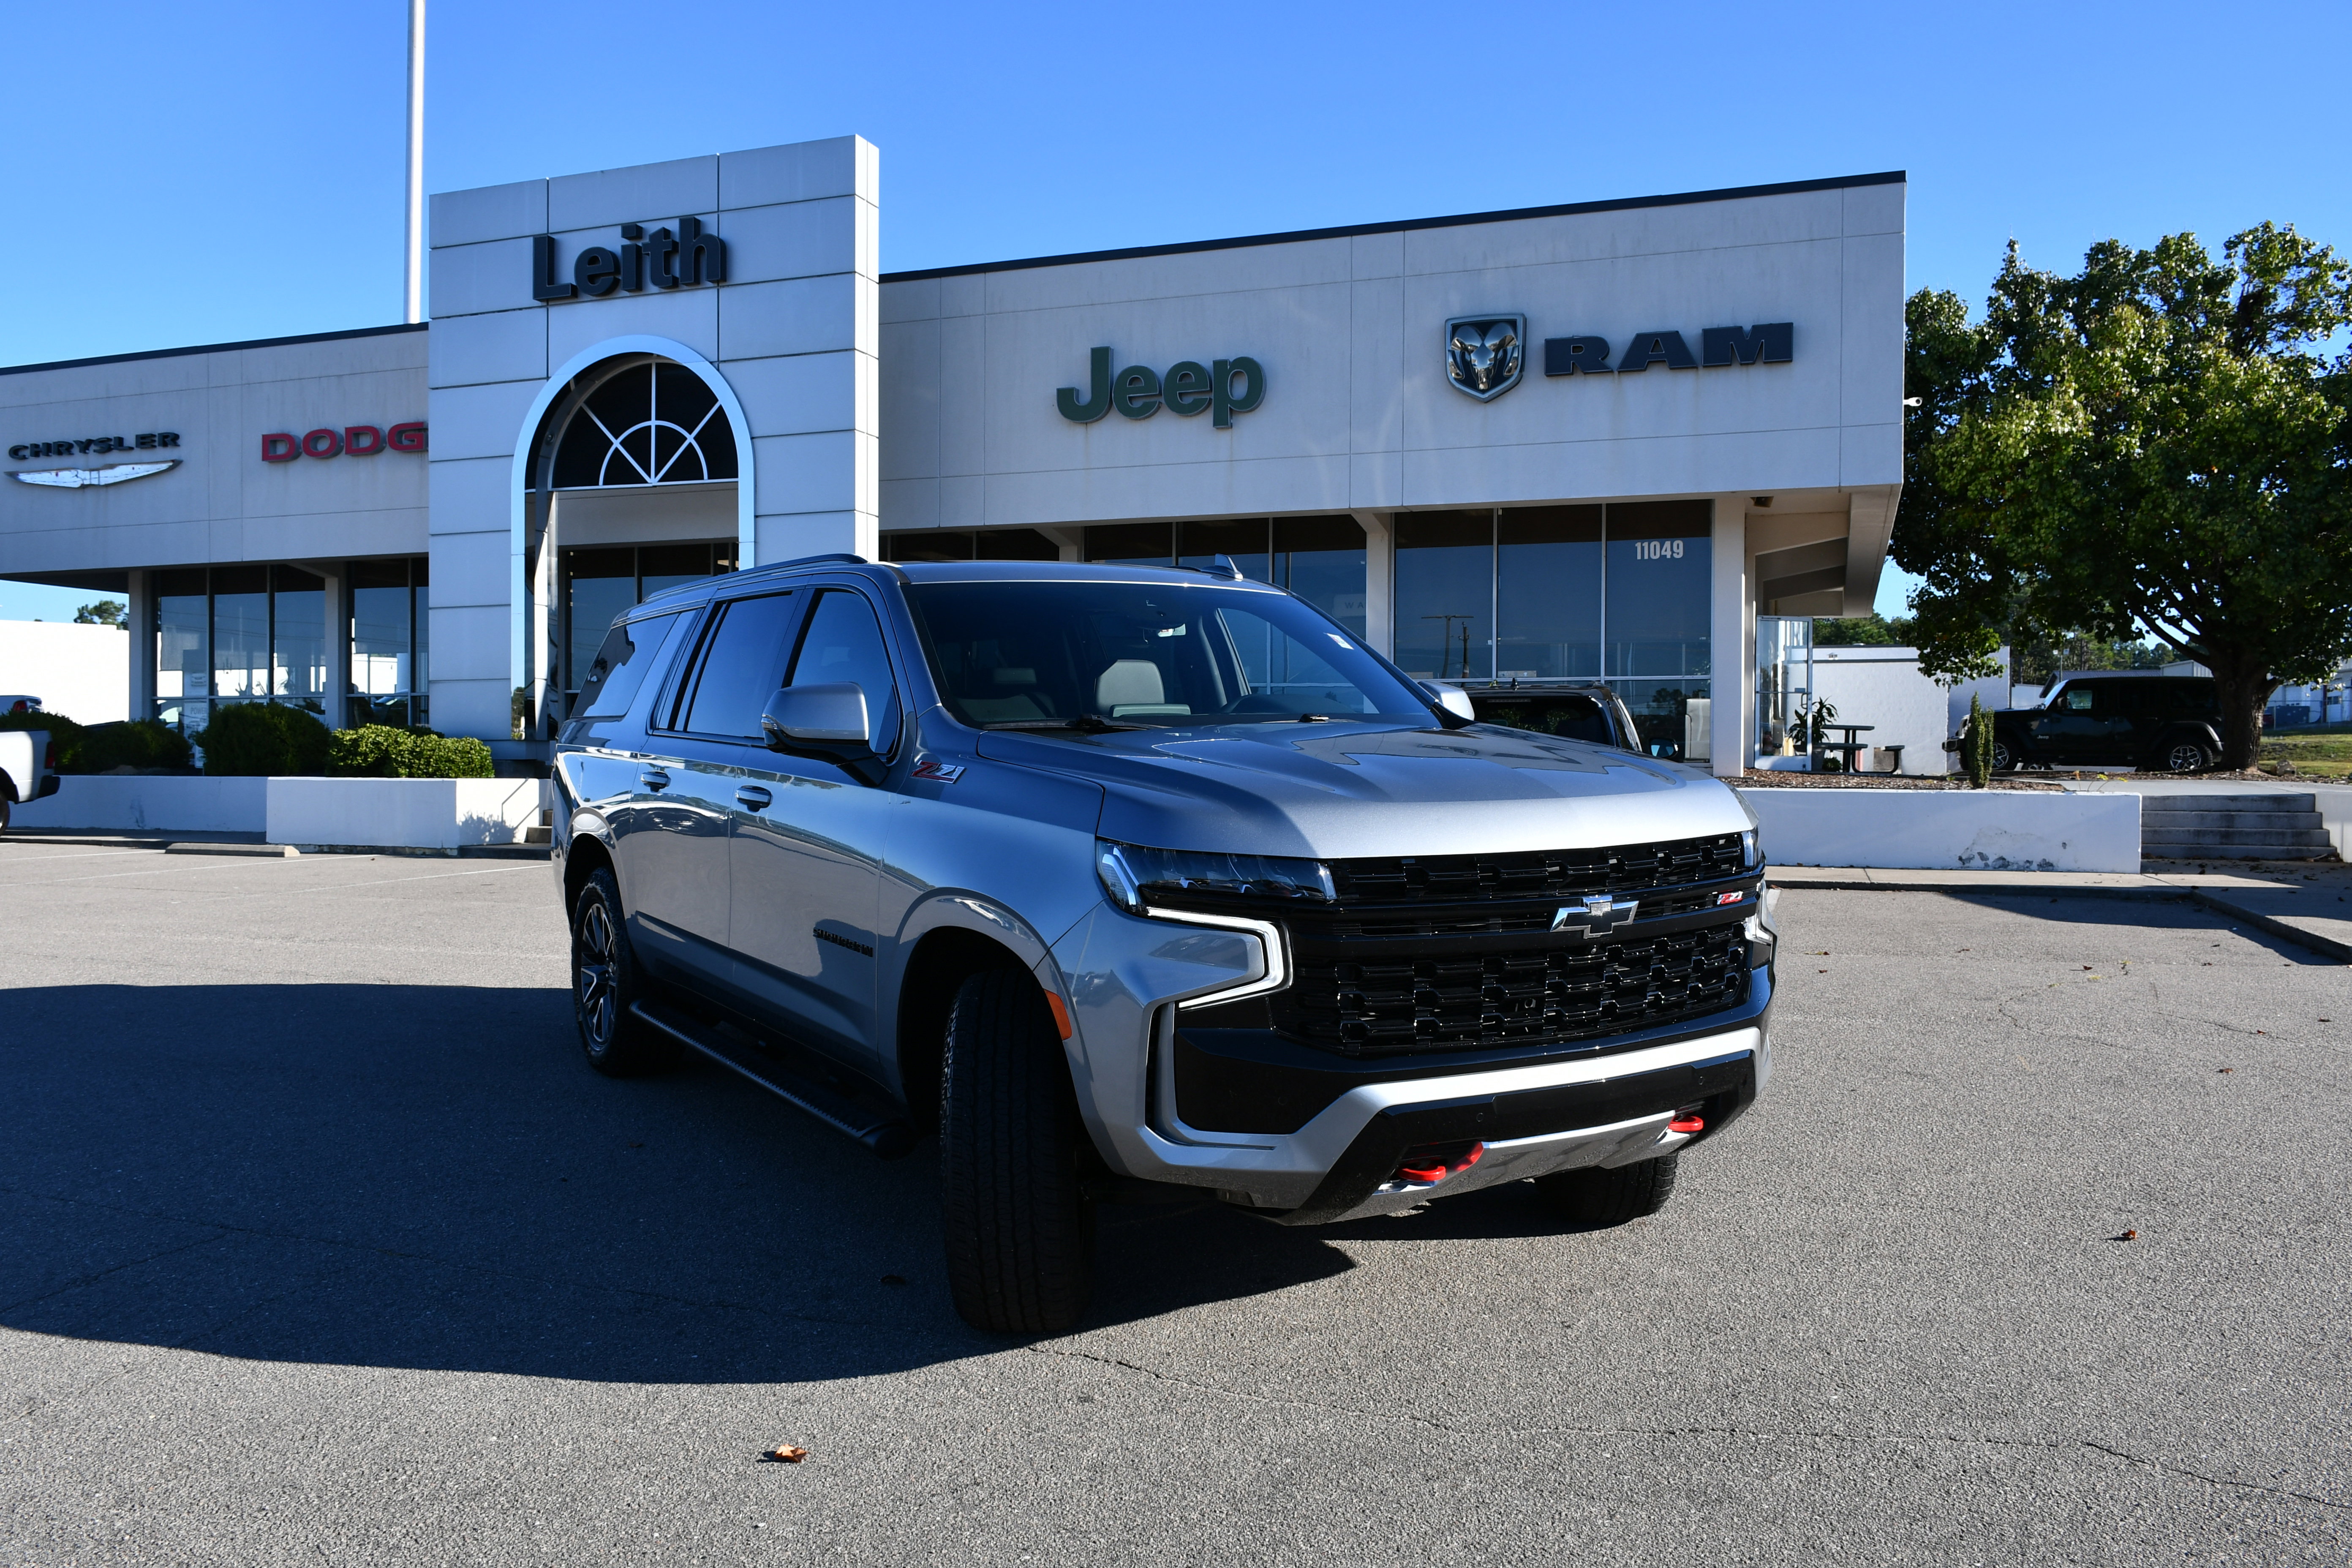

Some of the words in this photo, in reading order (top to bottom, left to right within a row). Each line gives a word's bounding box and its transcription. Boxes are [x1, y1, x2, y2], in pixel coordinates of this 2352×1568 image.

[533, 216, 727, 301] Leith
[1544, 322, 1794, 377] RAM
[1056, 346, 1266, 428] Jeep
[8, 432, 180, 460] CHRYSLER
[262, 422, 428, 463] DODG
[1635, 540, 1683, 560] 11049
[909, 760, 966, 784] Z71
[1717, 890, 1743, 905] Z71
